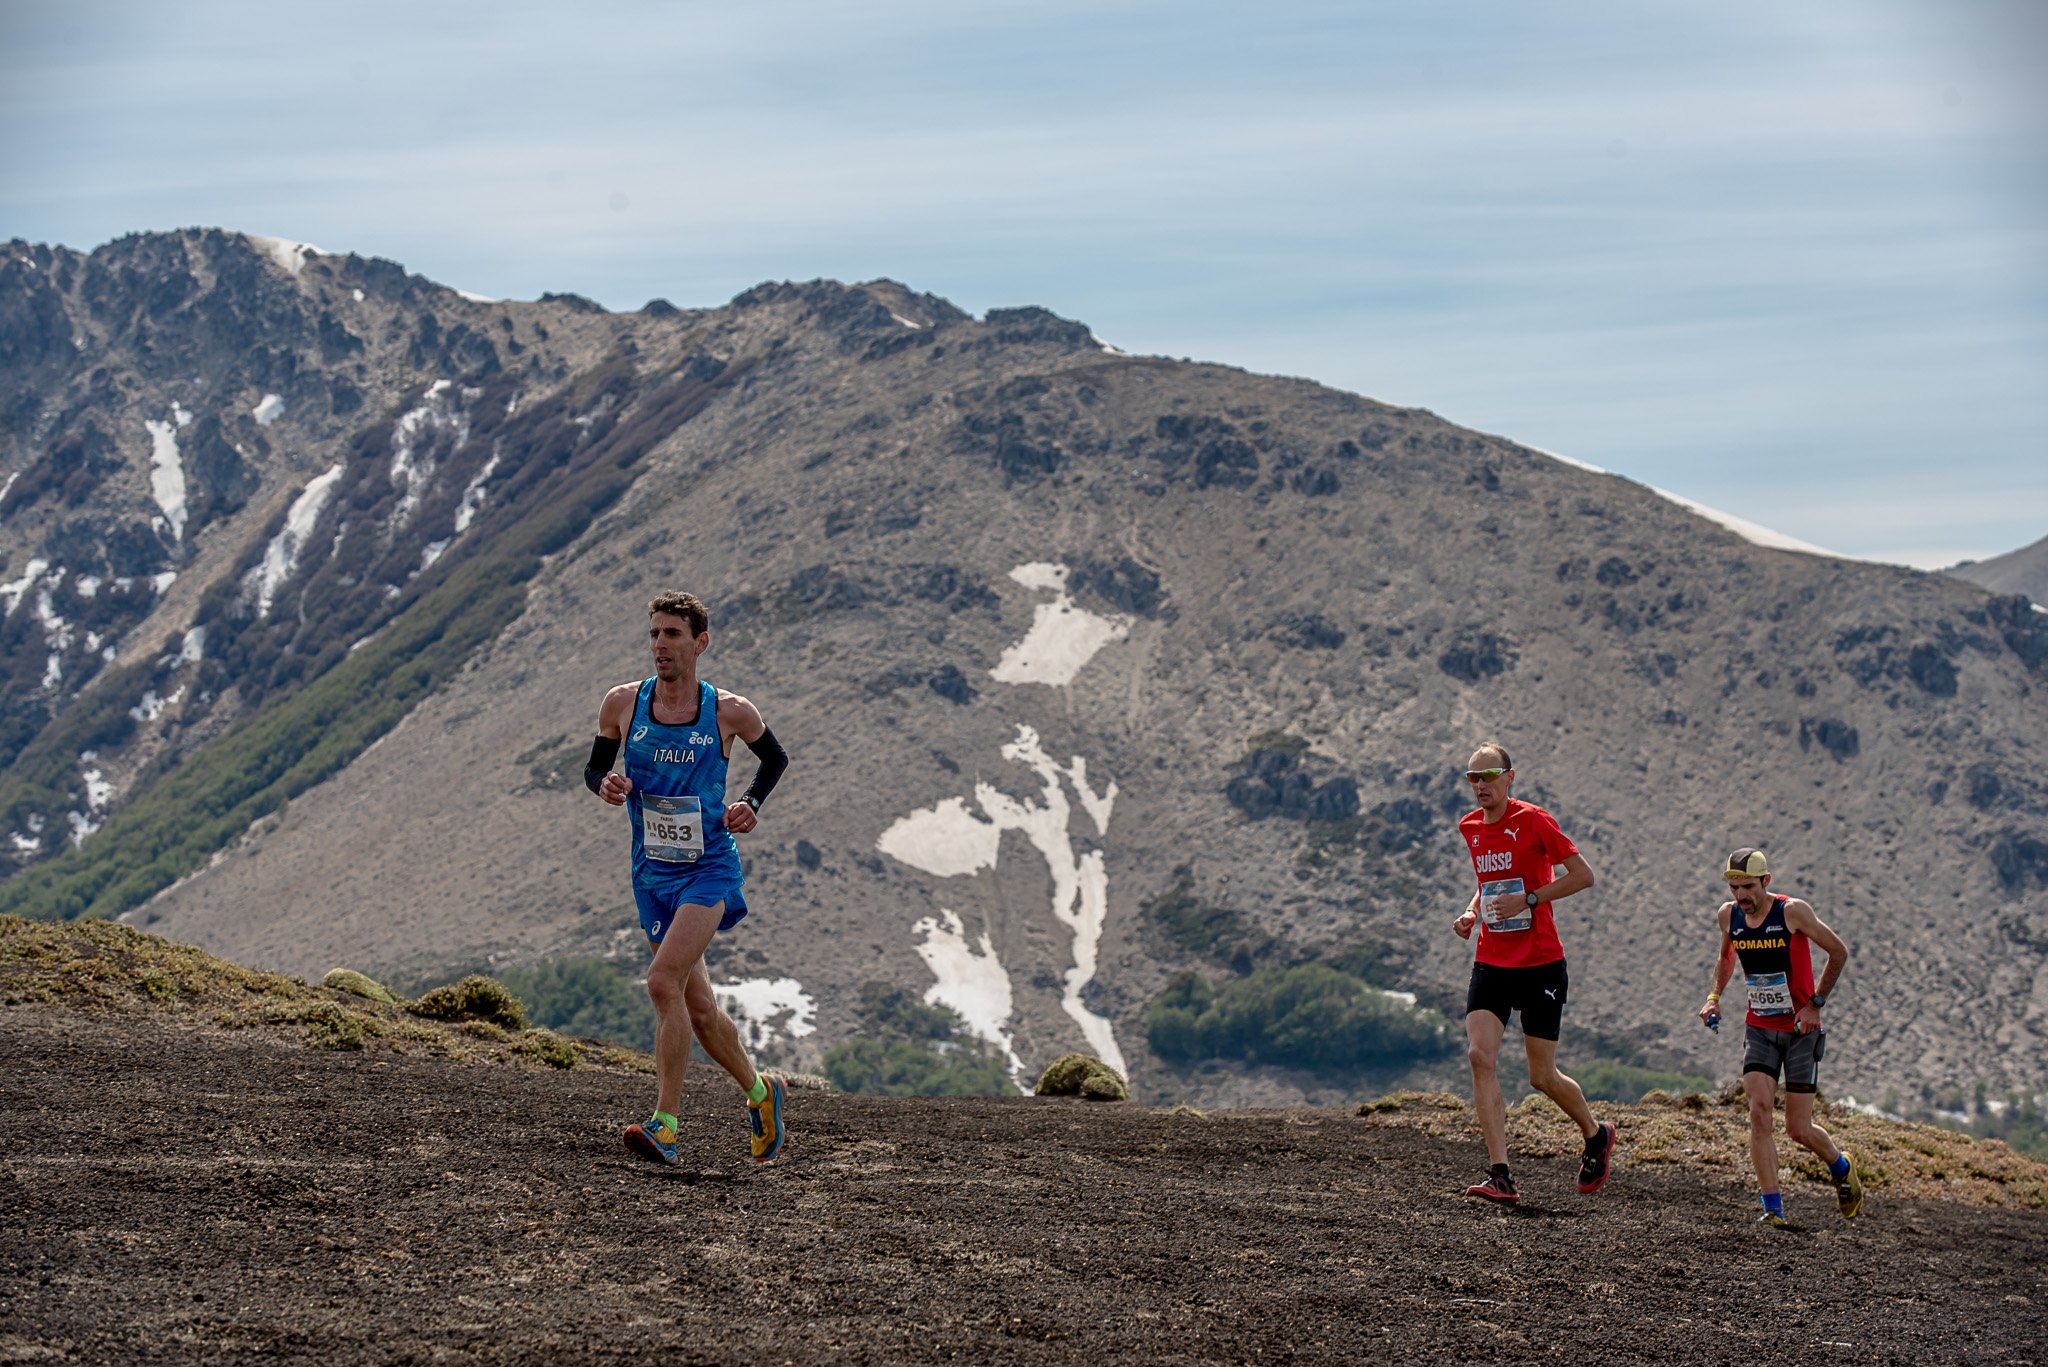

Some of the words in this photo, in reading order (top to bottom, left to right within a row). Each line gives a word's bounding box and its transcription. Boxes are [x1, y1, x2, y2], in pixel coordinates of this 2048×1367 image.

[689, 733, 714, 746] eolo
[653, 749, 695, 763] ITALIA
[656, 823, 693, 842] 653
[1475, 849, 1513, 874] suisse
[1732, 938, 1787, 950] ROMANIA
